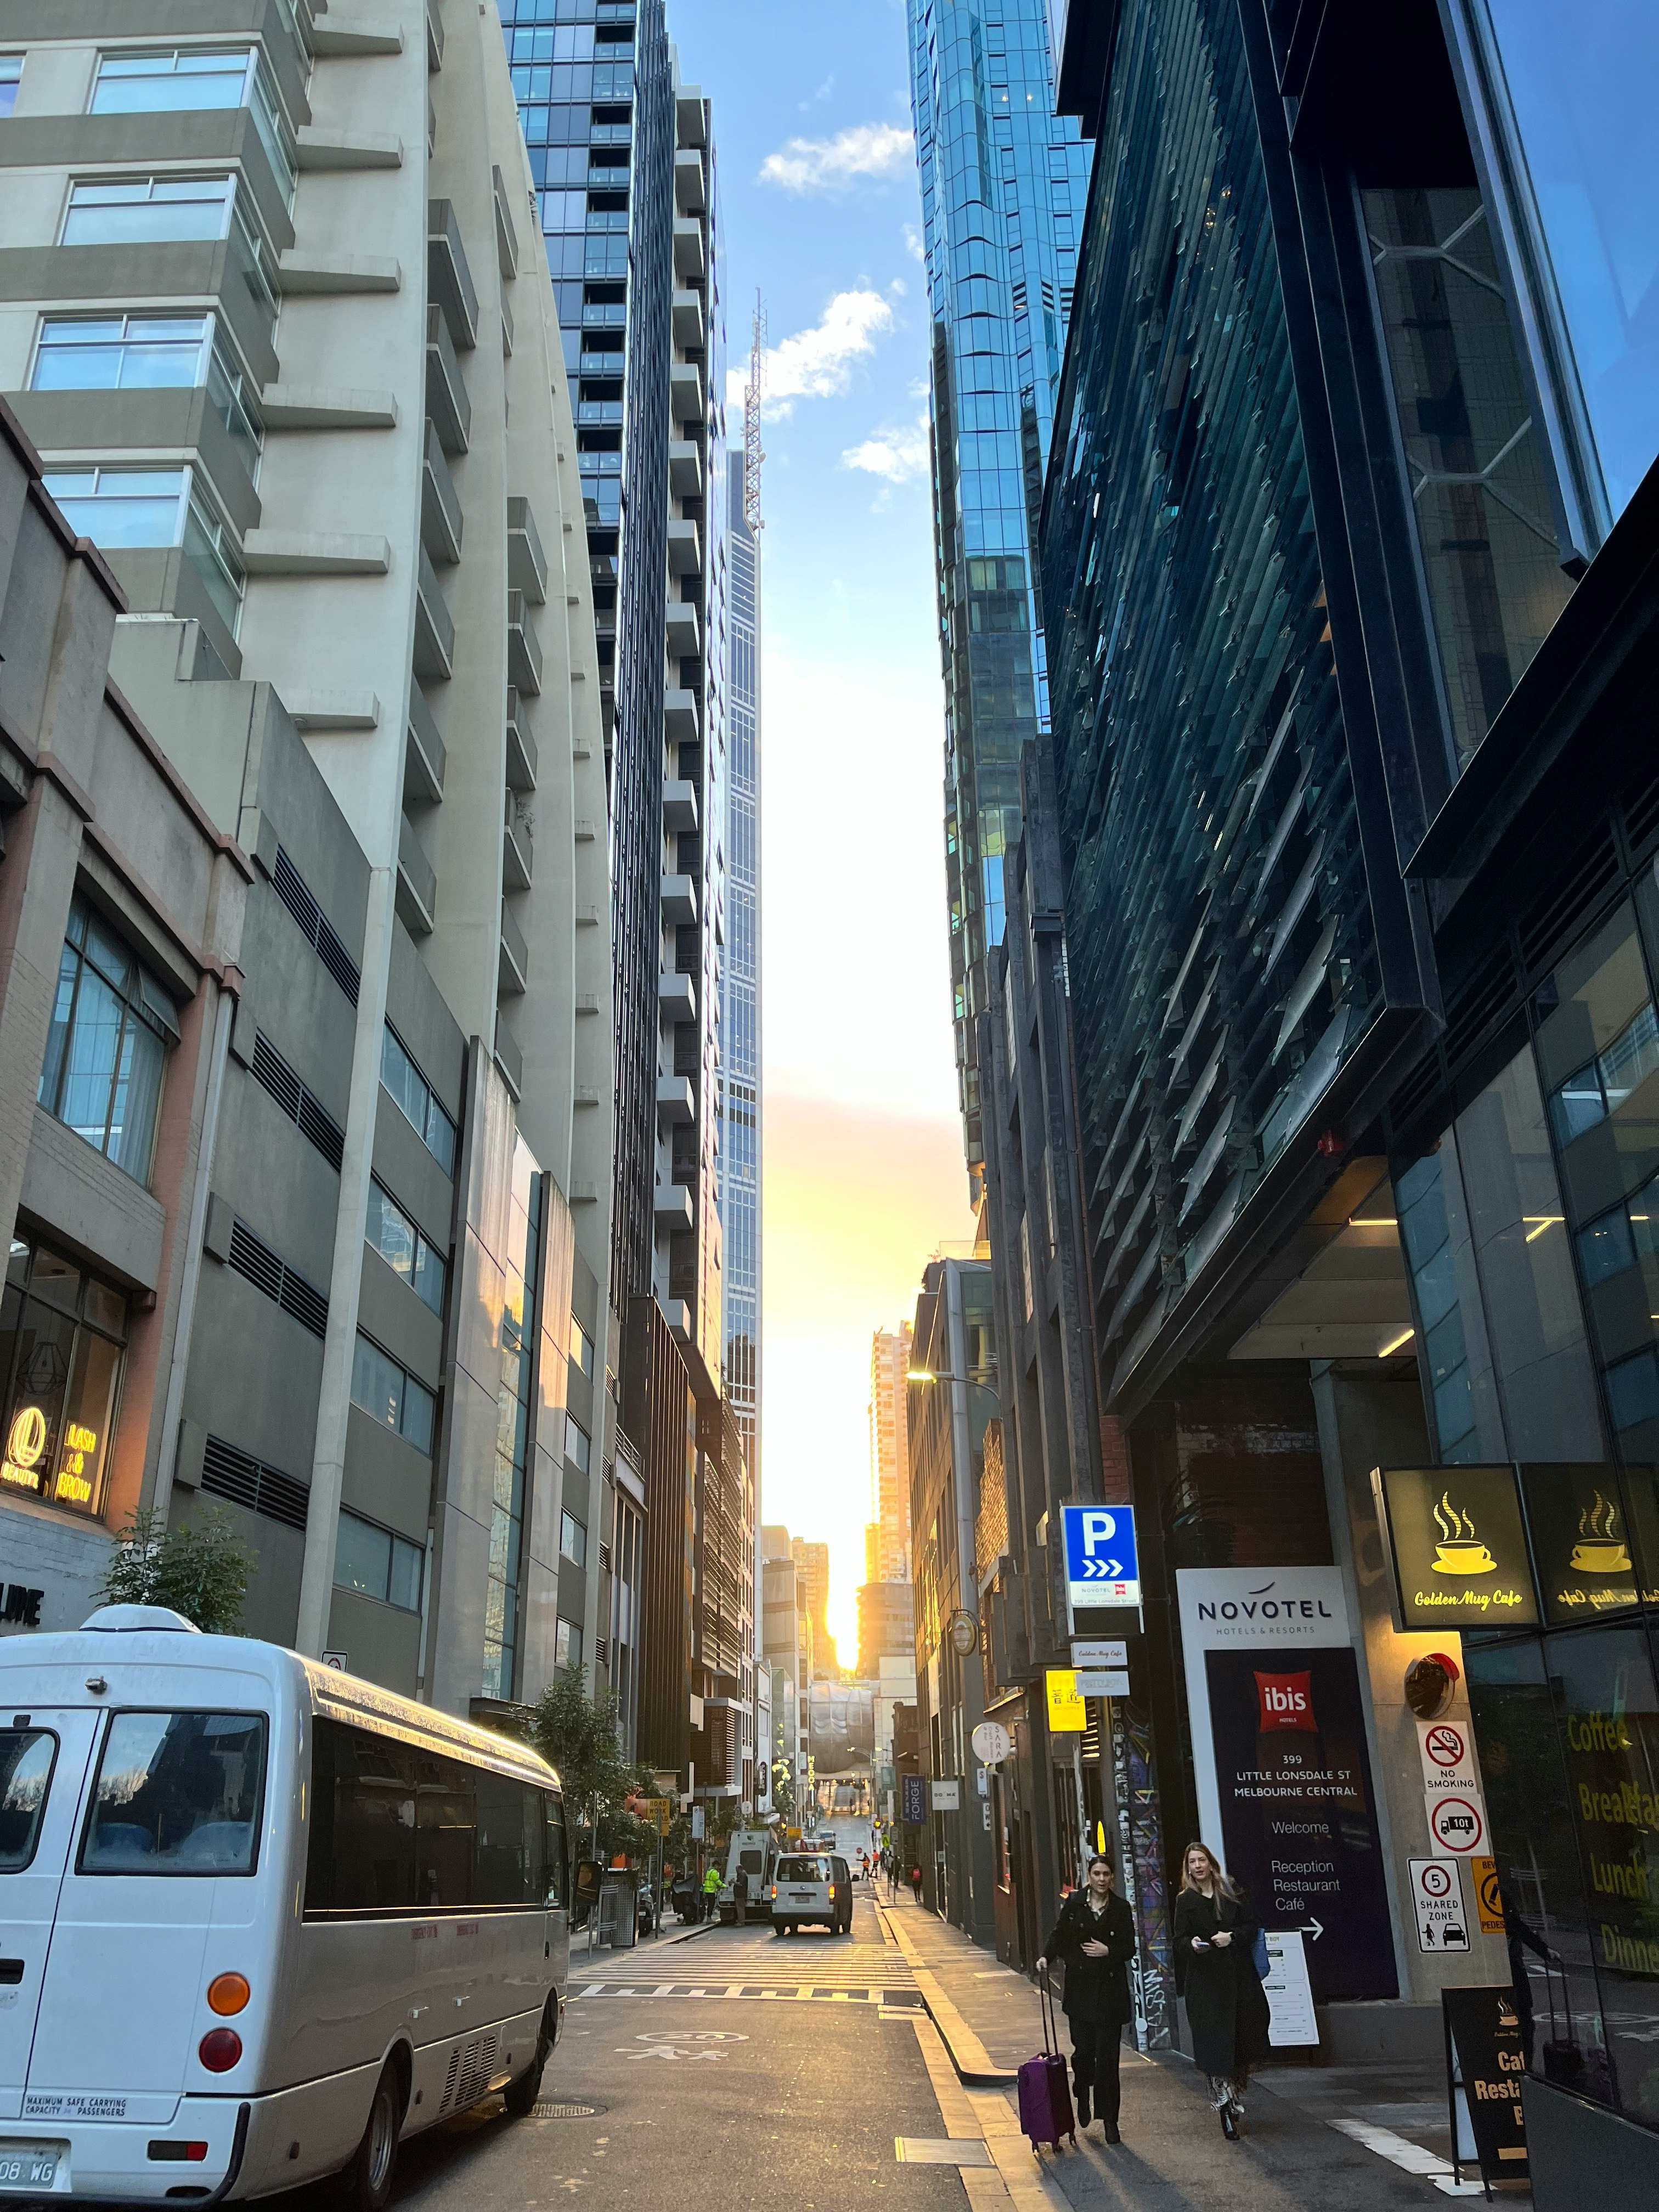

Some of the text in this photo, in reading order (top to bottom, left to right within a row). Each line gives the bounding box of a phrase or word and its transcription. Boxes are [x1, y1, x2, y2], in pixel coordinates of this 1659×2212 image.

[70, 1424, 97, 1453] LASH
[57, 1472, 92, 1503] BROW
[1082, 1512, 1116, 1556] P
[1414, 1589, 1522, 1611] Golden Mug Cafe
[1198, 1600, 1333, 1621] NOVOTEL
[1216, 1627, 1256, 1635] HOTELS
[1269, 1626, 1315, 1634] RESORTS
[1264, 1686, 1307, 1711] ibis
[1567, 1711, 1631, 1752] Coffee
[1283, 1755, 1302, 1764] 399
[1237, 1770, 1351, 1781] LITTLE LONSDALE ST
[1440, 1770, 1455, 1778] NO
[1427, 1779, 1474, 1788] SMOKING
[1234, 1786, 1358, 1797] MELBOURNE CENTRAL
[911, 1781, 920, 1820] FORGE
[1271, 1821, 1329, 1835] Welcome
[1453, 1818, 1469, 1829] 10t
[1271, 1860, 1334, 1875] Reception
[1431, 1875, 1441, 1888] 5
[1590, 1852, 1650, 1898] Lunch
[1273, 1879, 1341, 1892] Restaurant
[1275, 1897, 1305, 1911] Café
[1420, 1899, 1459, 1910] SHARED
[1429, 1911, 1454, 1921] ZONE
[1498, 2051, 1526, 2071] Caf
[27, 2096, 126, 2108] MAXIMUM SAFE CARRYING
[25, 2106, 60, 2114] CAPACITY
[77, 2107, 125, 2117] PASSENGERS
[30, 2163, 53, 2181] WG
